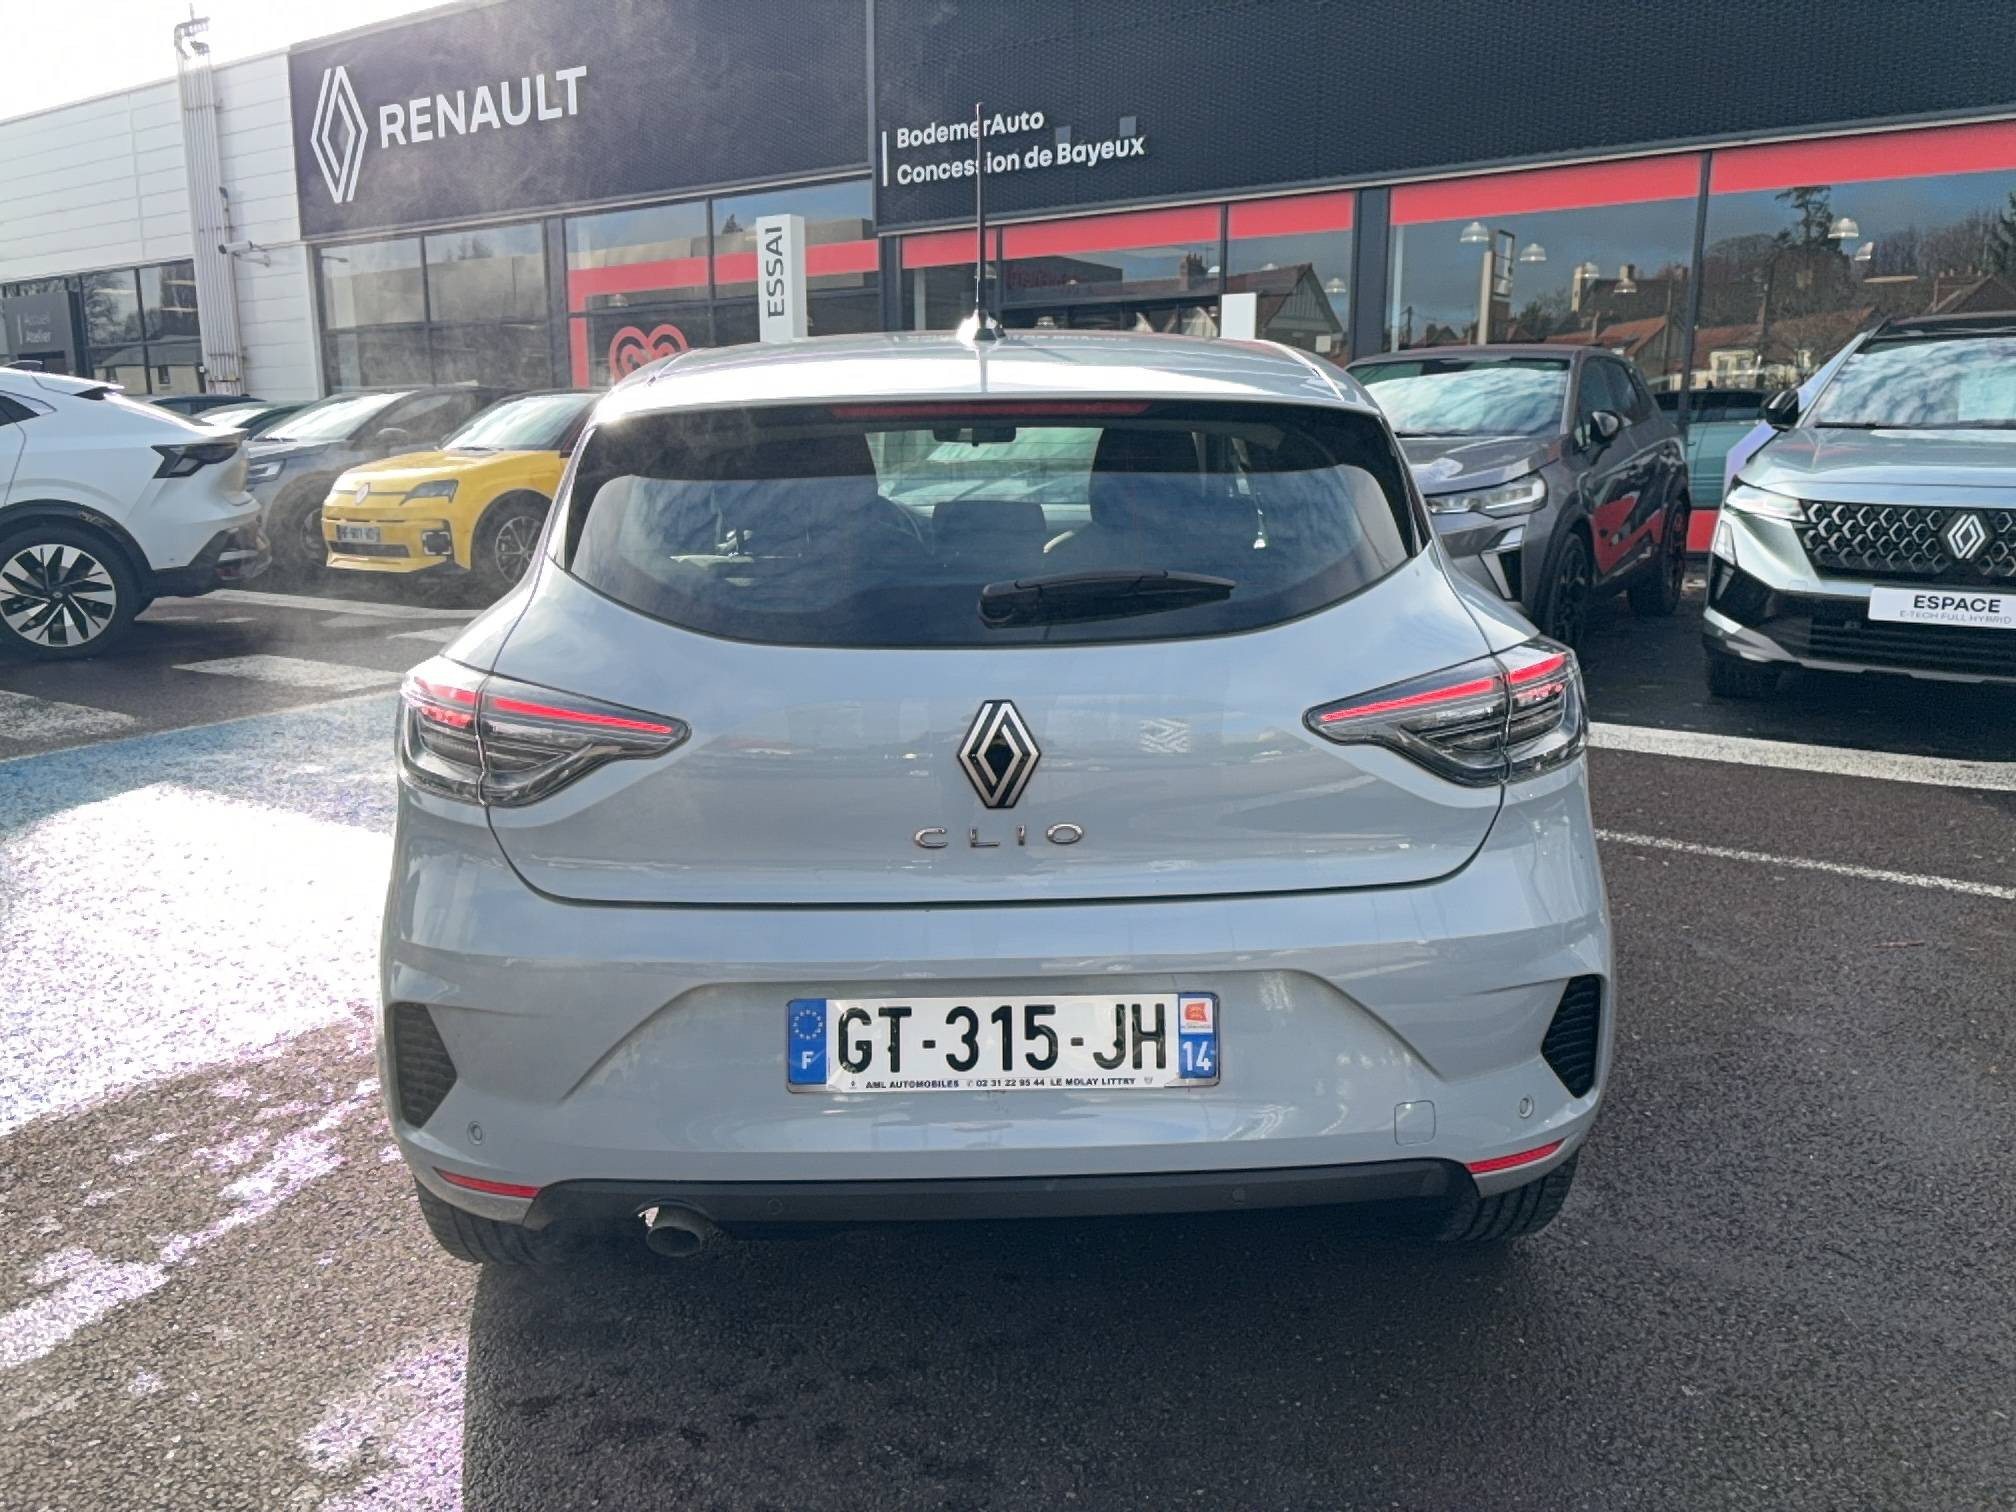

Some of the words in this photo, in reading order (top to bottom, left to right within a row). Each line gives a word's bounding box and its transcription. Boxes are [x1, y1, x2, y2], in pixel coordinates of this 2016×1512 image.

[379, 65, 588, 149] RENAULT
[896, 110, 1045, 149] BodemerAuto
[1024, 145, 1053, 168] de
[1056, 135, 1145, 167] Bayeux
[764, 226, 785, 318] ESSAI
[1899, 609, 1939, 620] E-TECH
[1940, 612, 1967, 622] FULL
[1969, 614, 2013, 625] HYBRID
[1913, 594, 2003, 614] ESPACE
[914, 823, 1084, 849] CLIO
[837, 1003, 1167, 1074] GT-315-JH
[801, 1050, 814, 1070] F
[1182, 1040, 1213, 1072] 14
[889, 1079, 960, 1089] AUTOMOBILES
[976, 1079, 988, 1088] 02
[991, 1079, 1002, 1087] 31
[1004, 1079, 1017, 1087] 22
[1033, 1078, 1046, 1087] 44
[1050, 1078, 1063, 1087] LE
[1065, 1078, 1099, 1087] MOLAY
[1101, 1077, 1137, 1086] LITTRY
